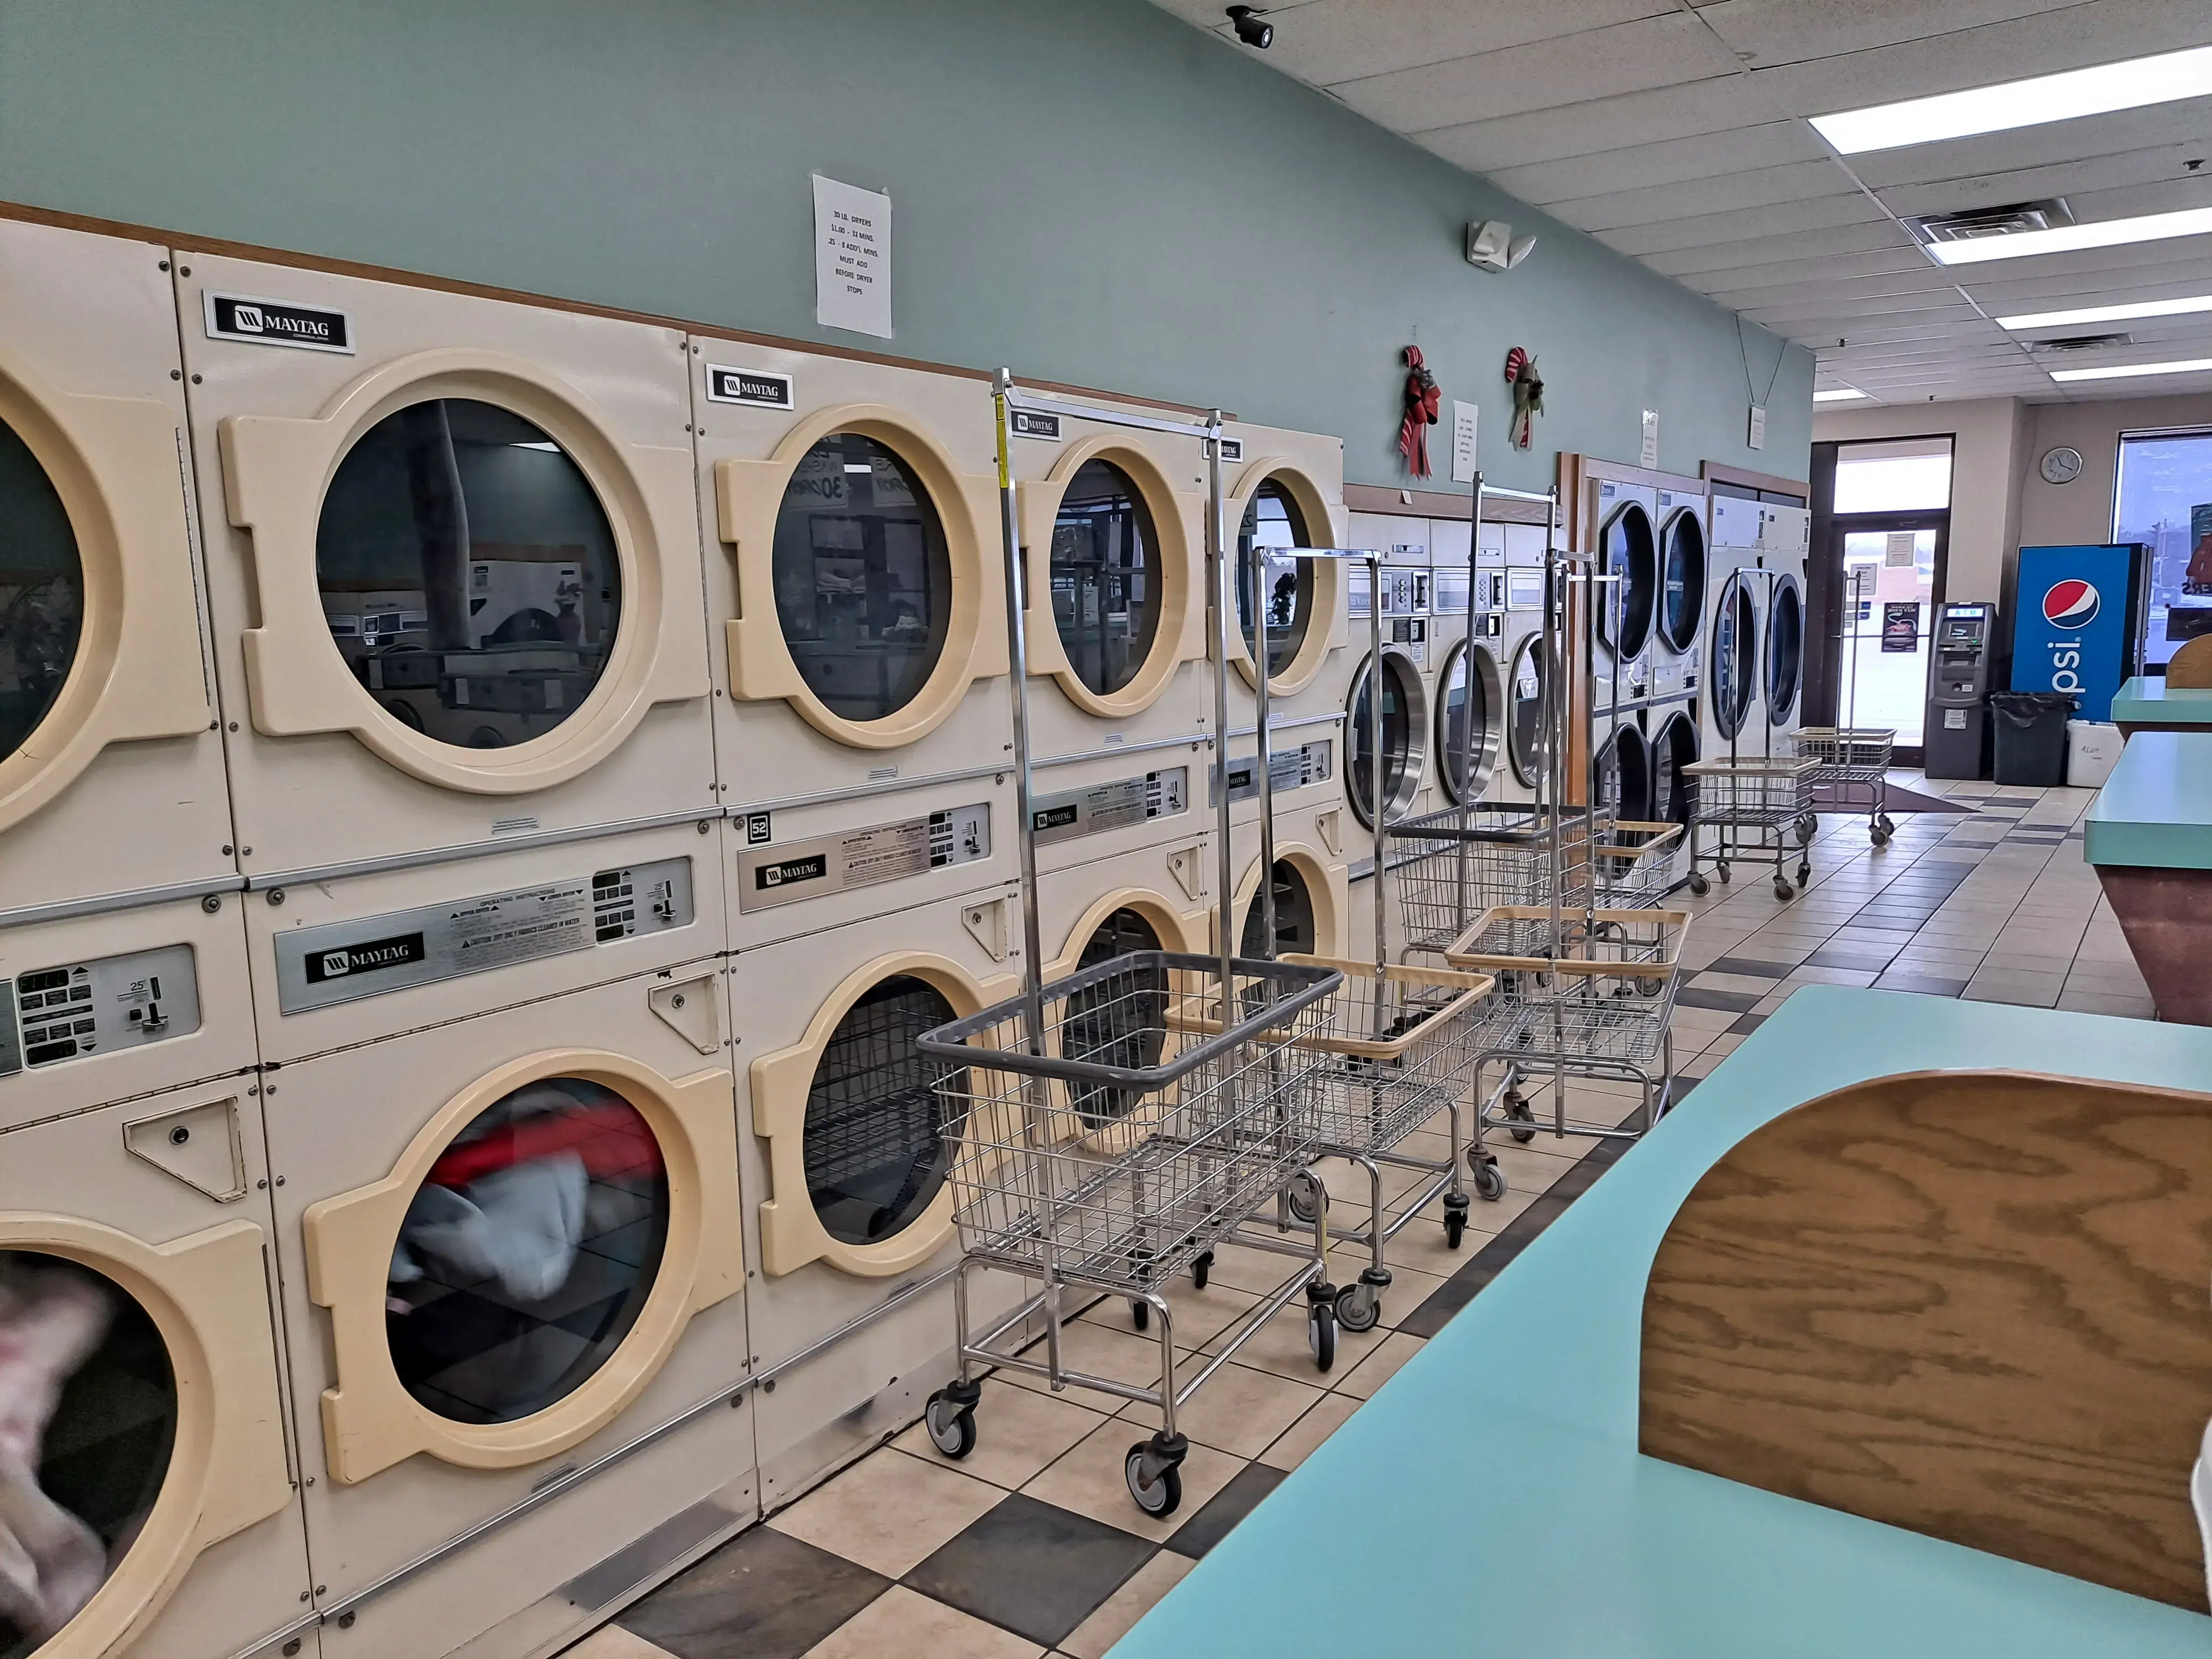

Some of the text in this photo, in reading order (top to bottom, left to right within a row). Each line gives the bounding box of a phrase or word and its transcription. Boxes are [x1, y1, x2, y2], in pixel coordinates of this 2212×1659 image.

[852, 216, 872, 227] DRYERS
[831, 223, 845, 234] $1.00
[859, 232, 874, 242] MINS.
[864, 248, 879, 257] MINS.
[839, 255, 868, 268] MUST ADD
[836, 268, 873, 283] BEFORE DRYER
[847, 285, 863, 295] STOPS
[265, 315, 328, 336] MAYTAG
[741, 382, 778, 397] MAYTAG
[1029, 420, 1053, 431] MAYTAG
[2047, 641, 2086, 710] psi
[1048, 812, 1071, 823] MAYTAG
[752, 822, 766, 834] 52
[782, 863, 817, 878] MAYTAG
[480, 888, 555, 907] OPERATING INSTRUCTIONS
[351, 945, 409, 967] MAYTAG
